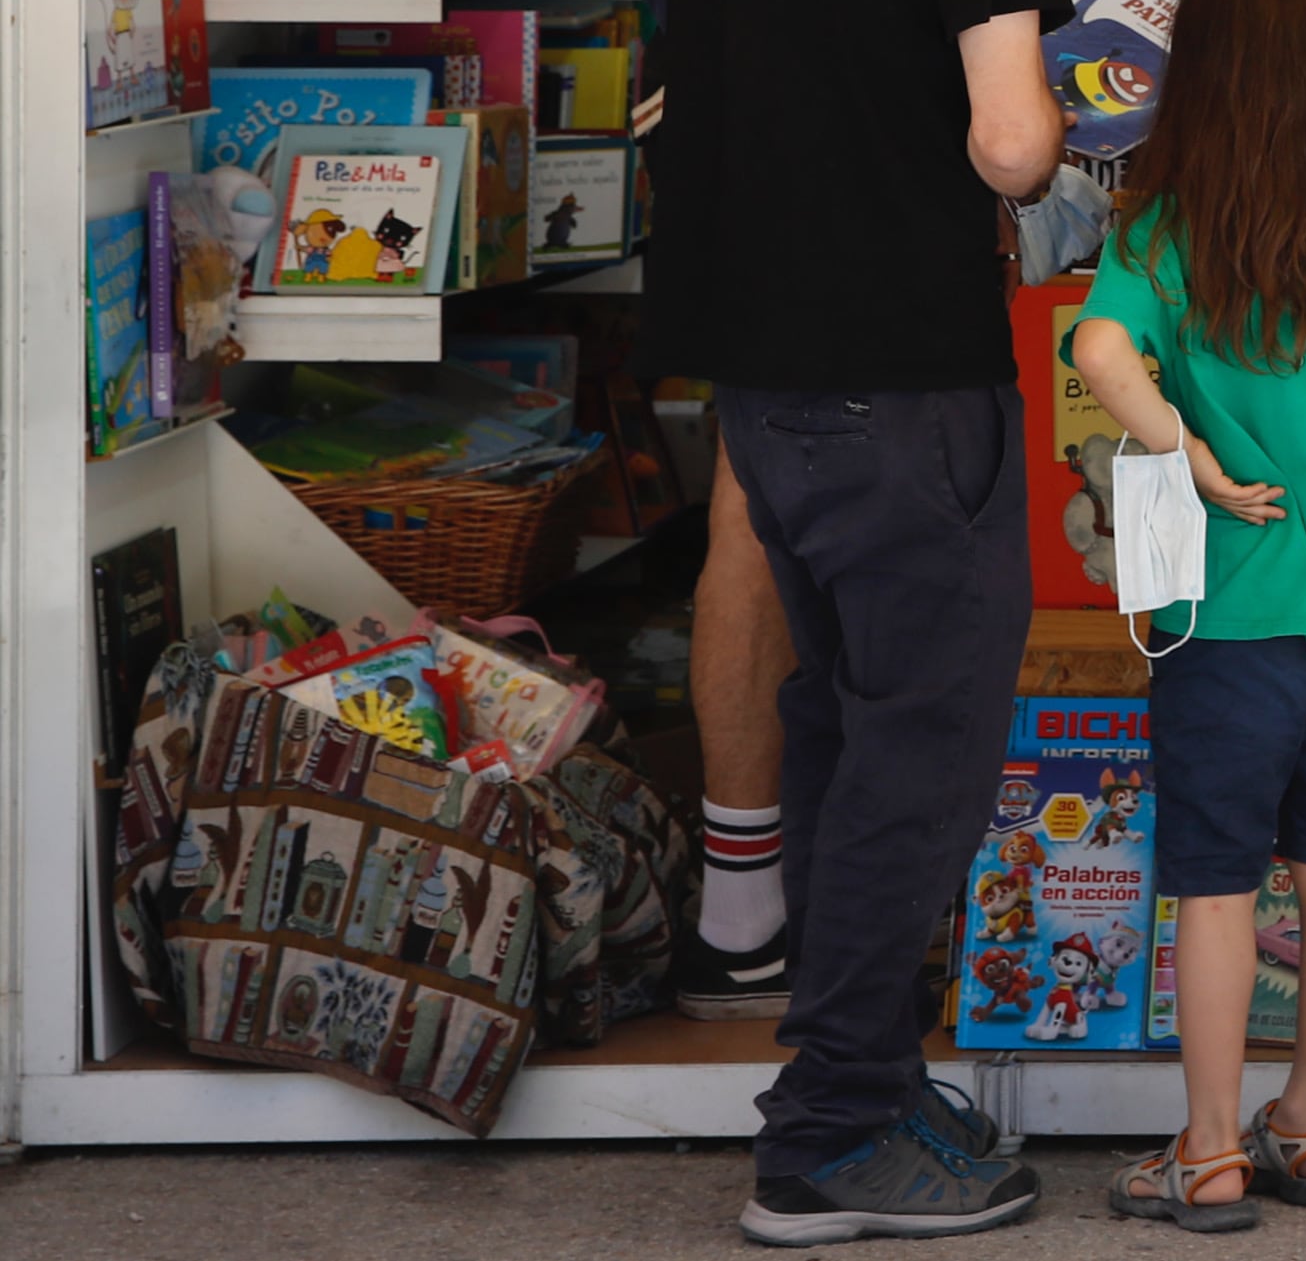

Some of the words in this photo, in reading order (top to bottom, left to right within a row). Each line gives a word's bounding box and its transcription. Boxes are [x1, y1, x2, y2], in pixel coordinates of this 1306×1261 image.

[1057, 800, 1077, 813] 30
[1042, 865, 1141, 885] Palabras
[1042, 886, 1066, 902] en
[1070, 884, 1140, 902] acción
